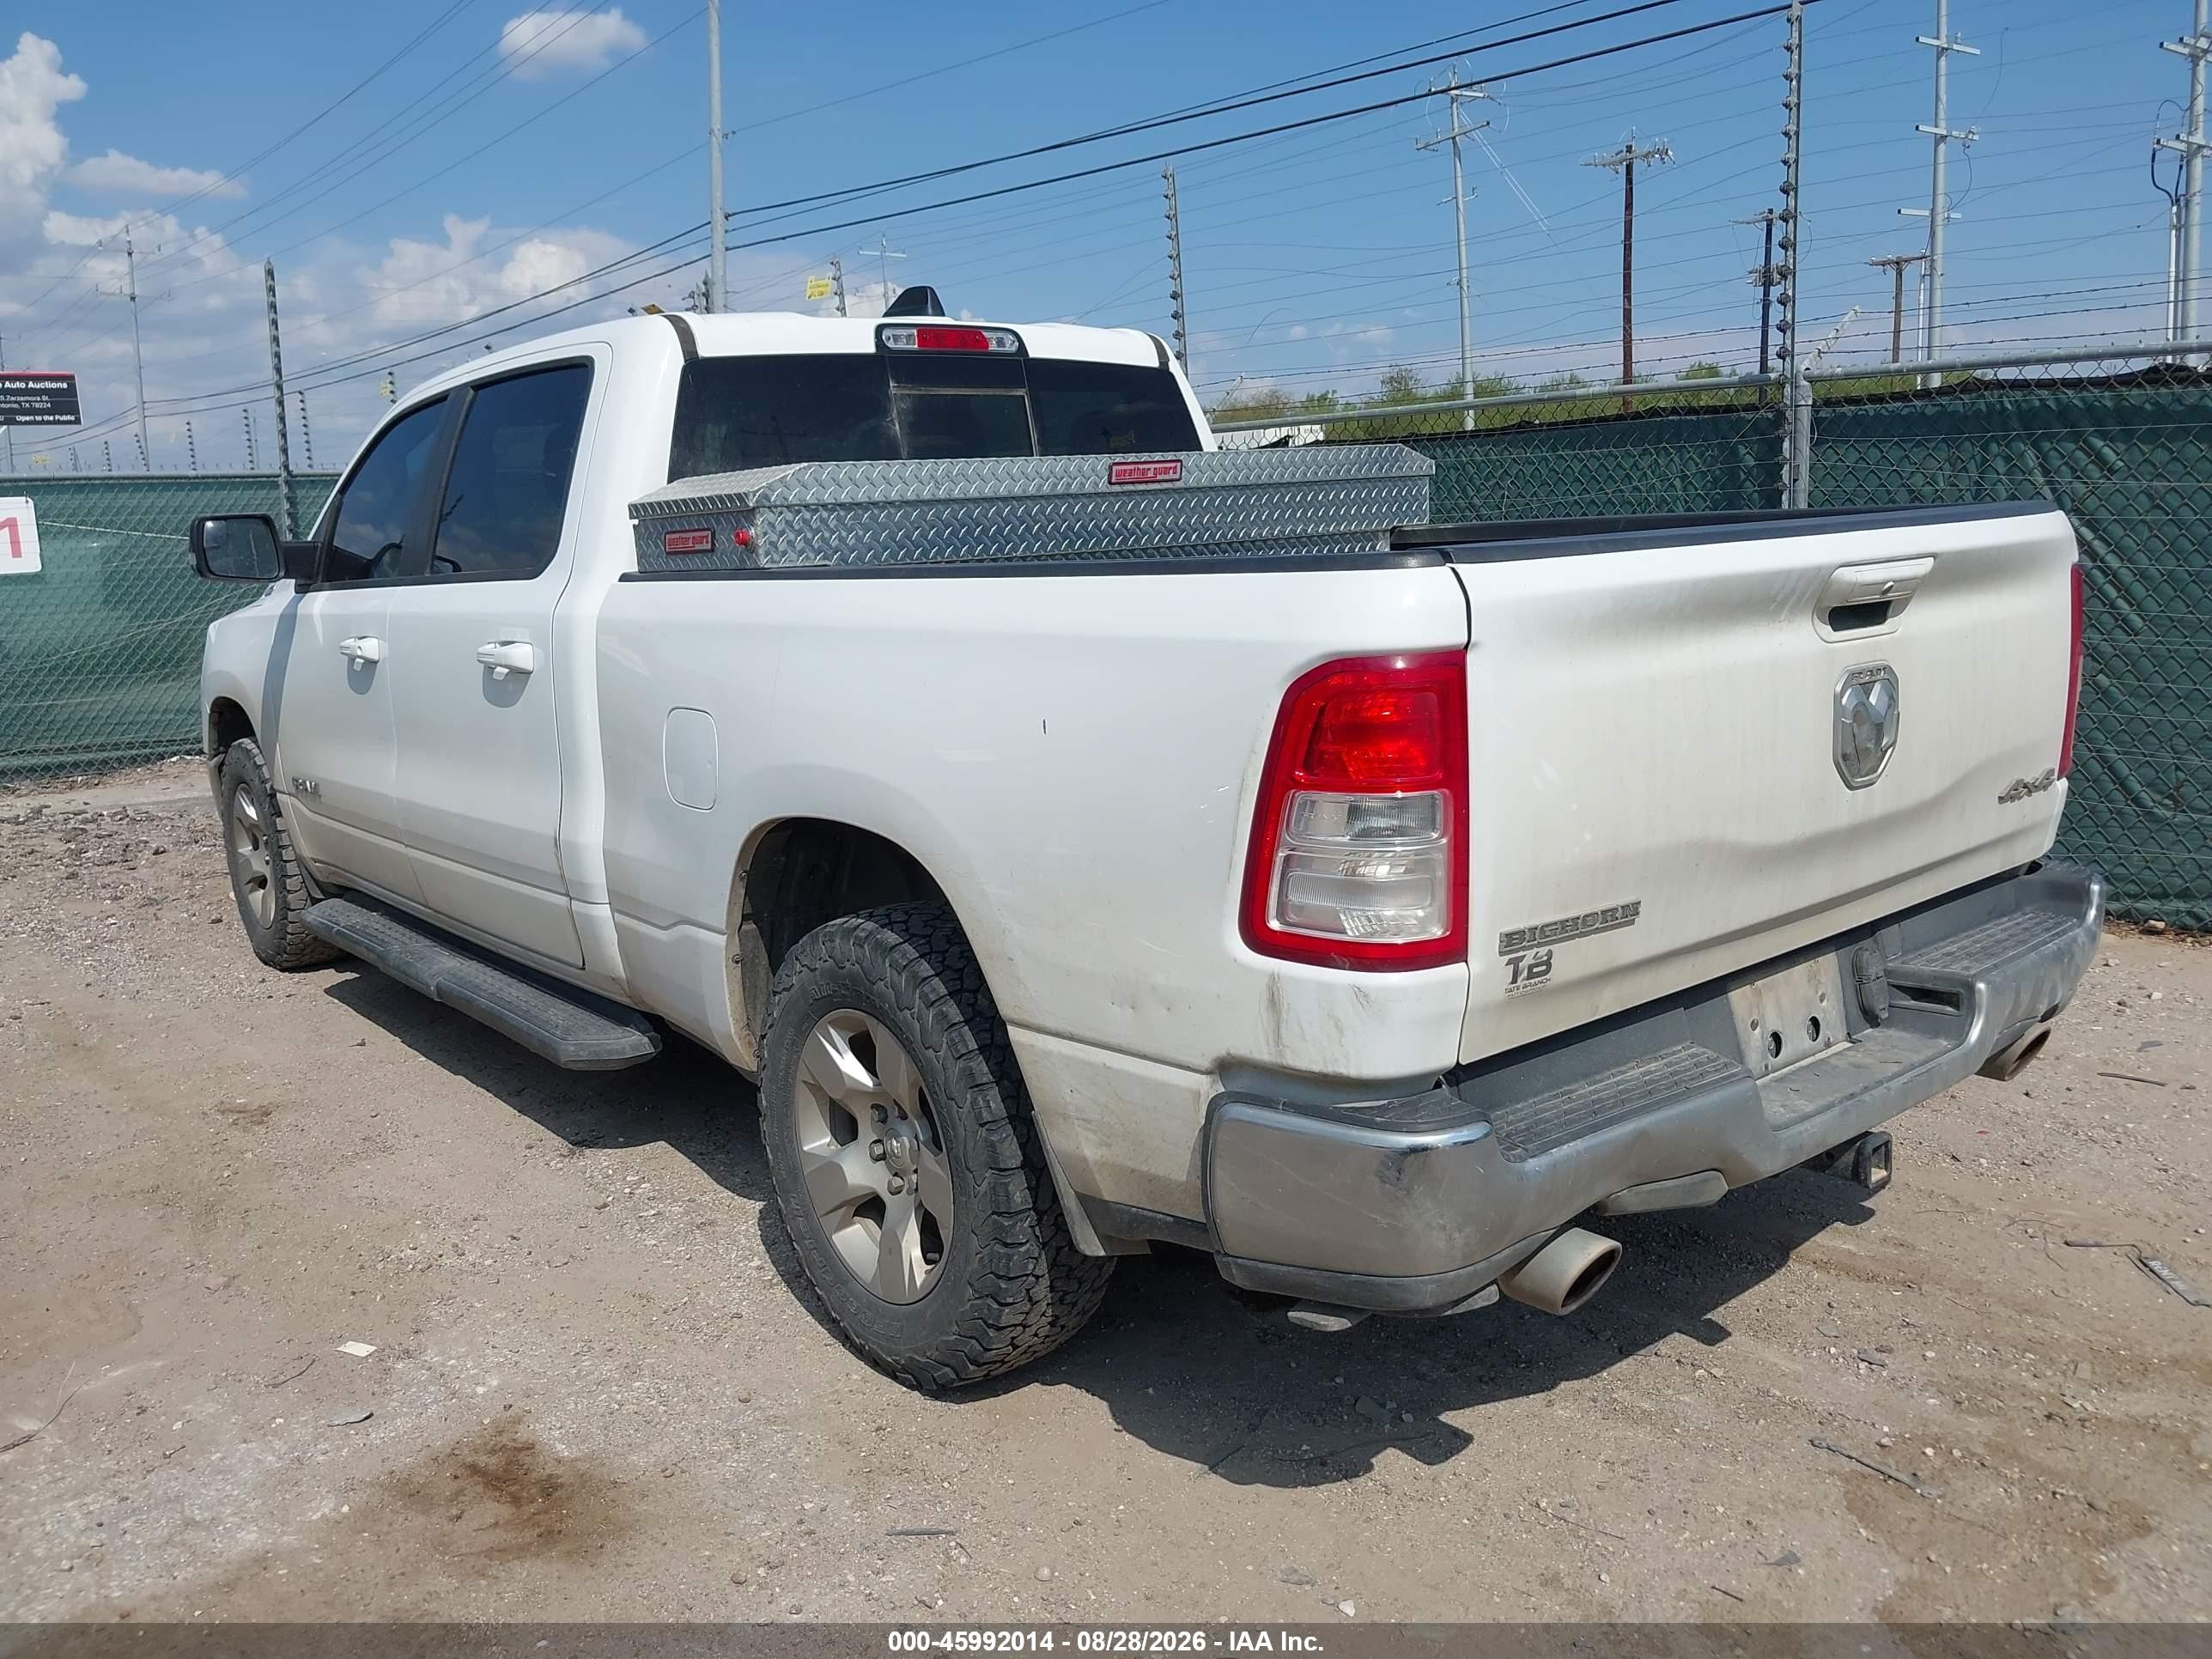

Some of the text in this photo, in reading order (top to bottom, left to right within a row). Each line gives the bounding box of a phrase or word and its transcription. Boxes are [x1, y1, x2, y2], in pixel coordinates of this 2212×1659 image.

[1115, 464, 1177, 478] weather guard
[1851, 666, 1887, 680] RAM
[1498, 900, 1642, 952] BIGHORN
[1504, 977, 1552, 994] TATE BRANCH
